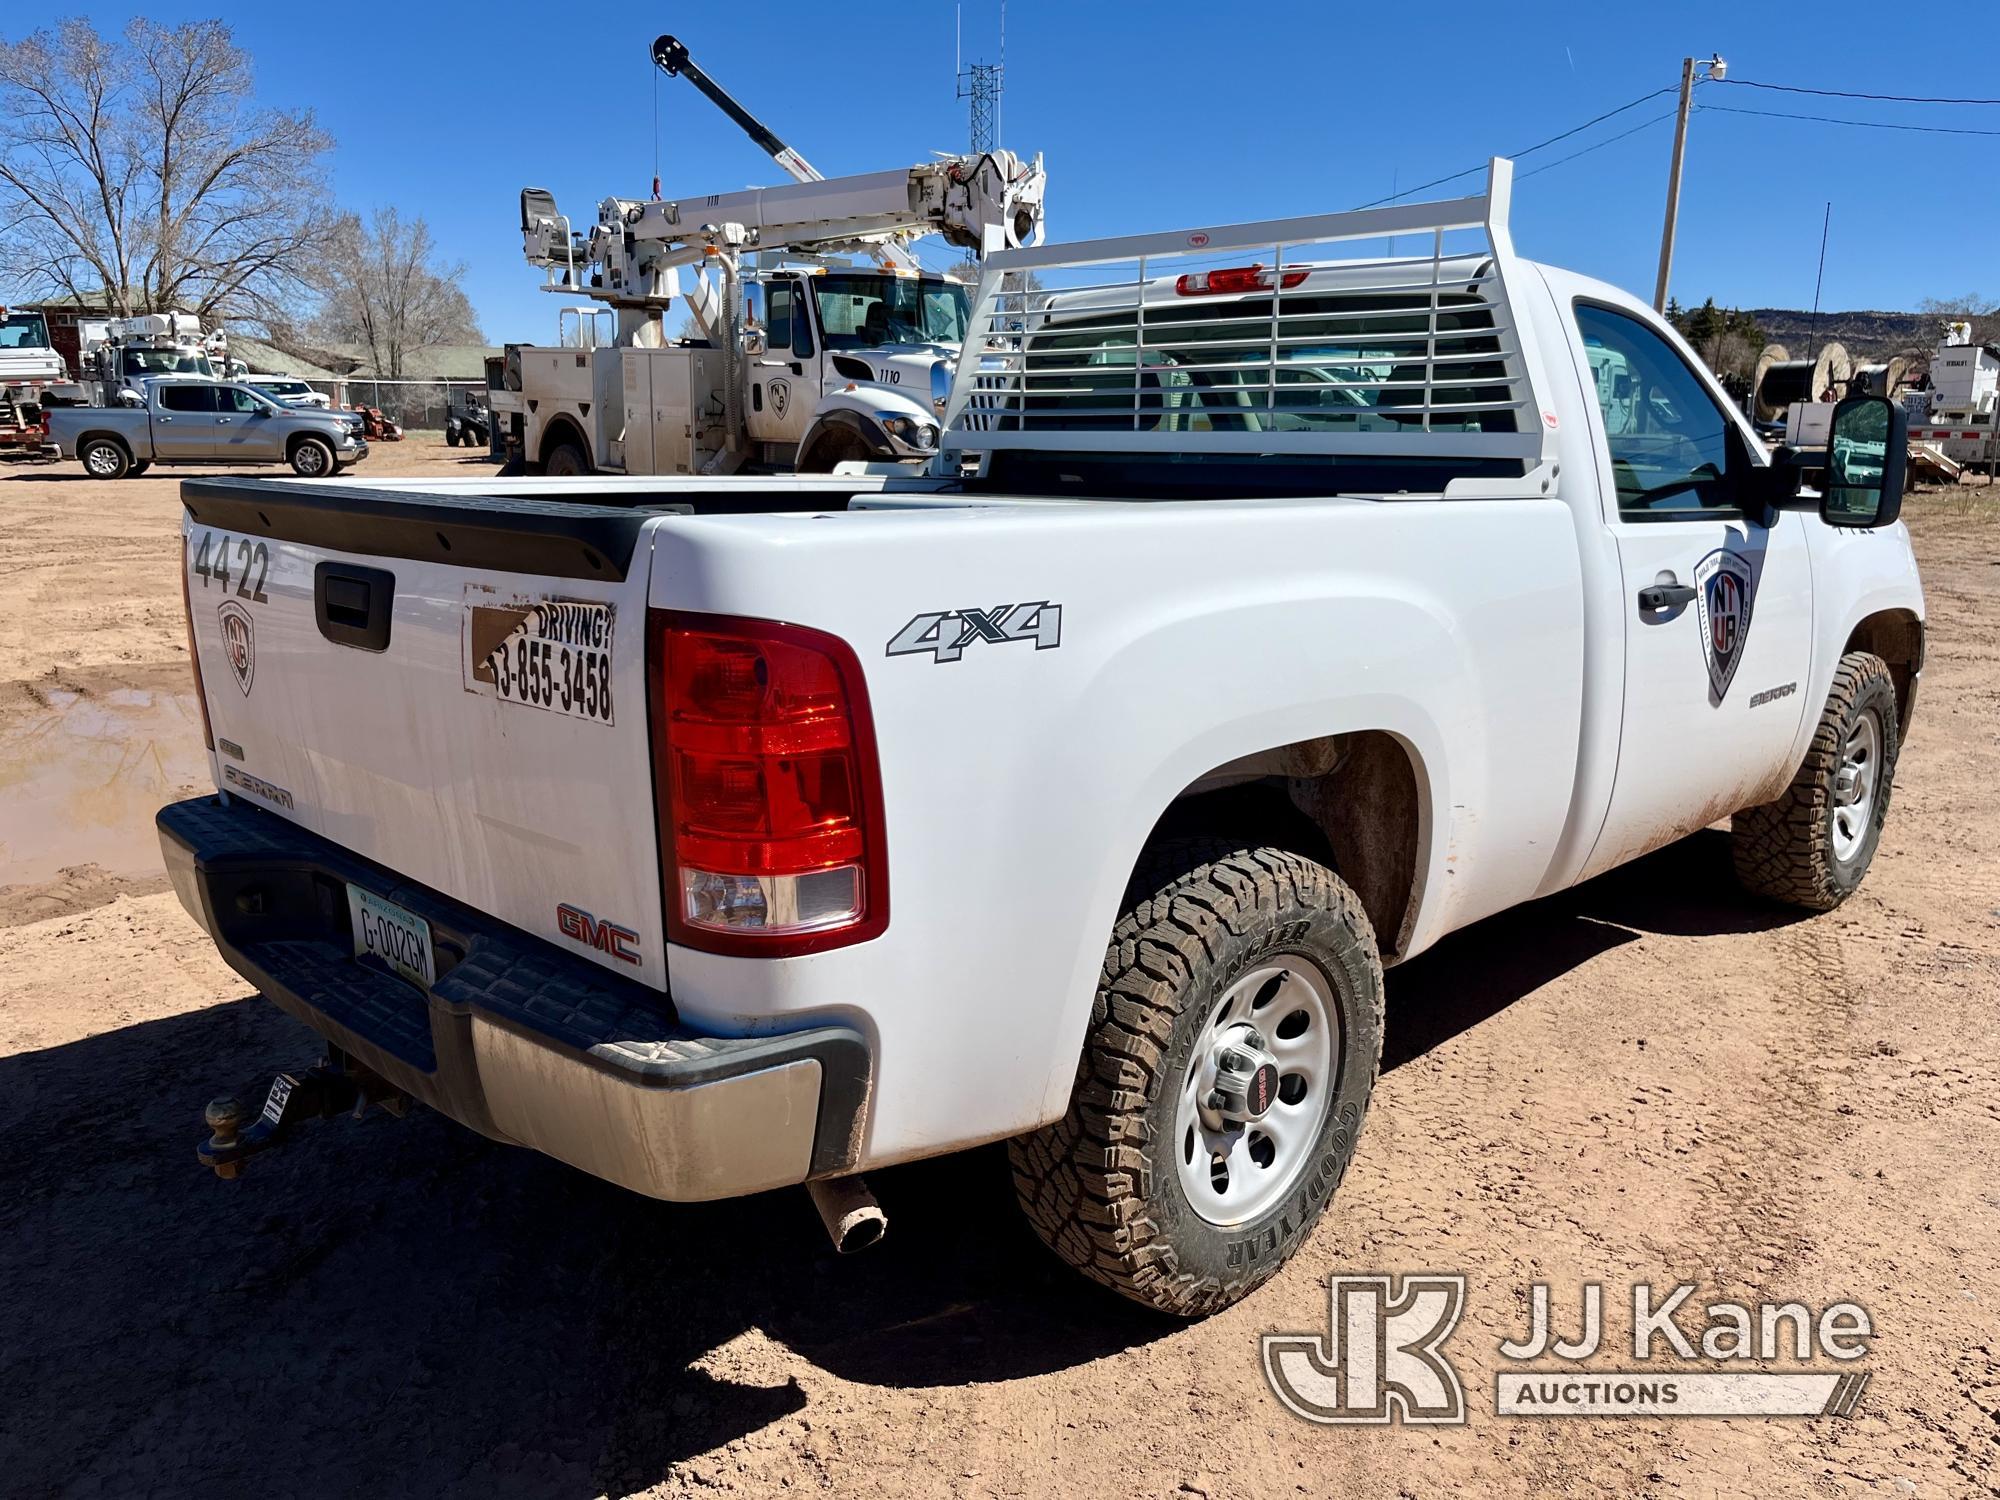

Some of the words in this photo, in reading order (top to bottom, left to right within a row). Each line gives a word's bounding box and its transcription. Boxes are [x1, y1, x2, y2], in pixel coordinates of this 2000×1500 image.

[880, 368, 900, 384] 1110
[534, 603, 612, 649] DRIVING?
[224, 764, 294, 811] SIERRA
[556, 902, 642, 968] GMC
[1258, 1070, 1267, 1113] GMC
[1226, 1101, 1359, 1269] GOODYEAR
